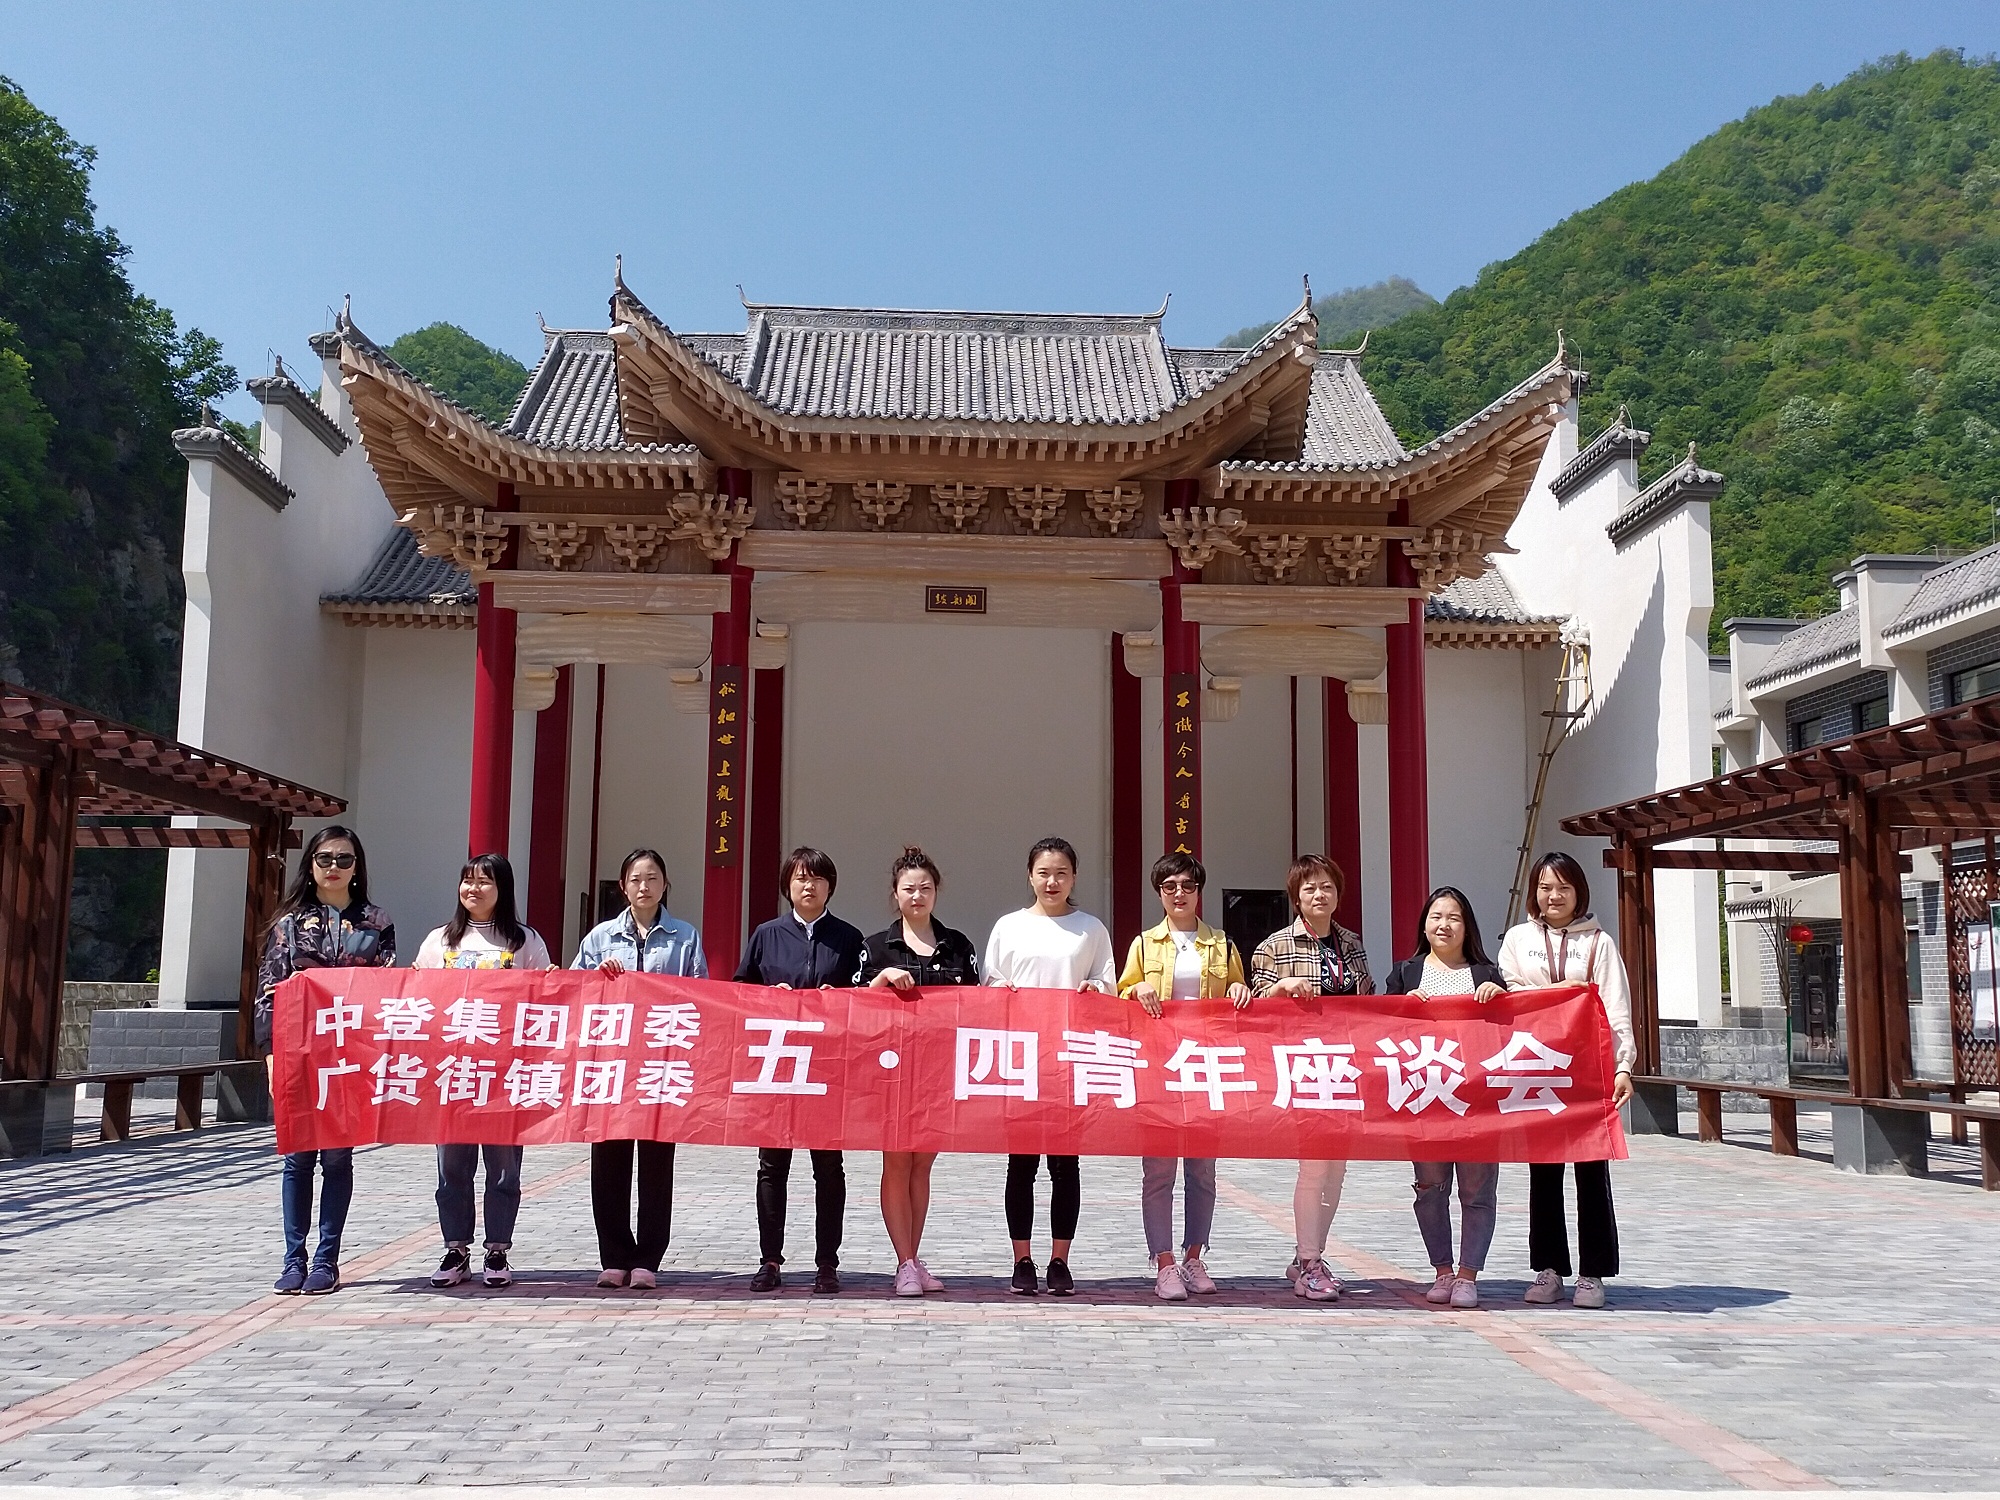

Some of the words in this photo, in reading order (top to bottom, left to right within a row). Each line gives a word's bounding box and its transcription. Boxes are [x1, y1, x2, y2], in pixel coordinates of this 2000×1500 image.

[315, 996, 701, 1049] 中登集团团委
[316, 1054, 695, 1110] 广货街镇团委
